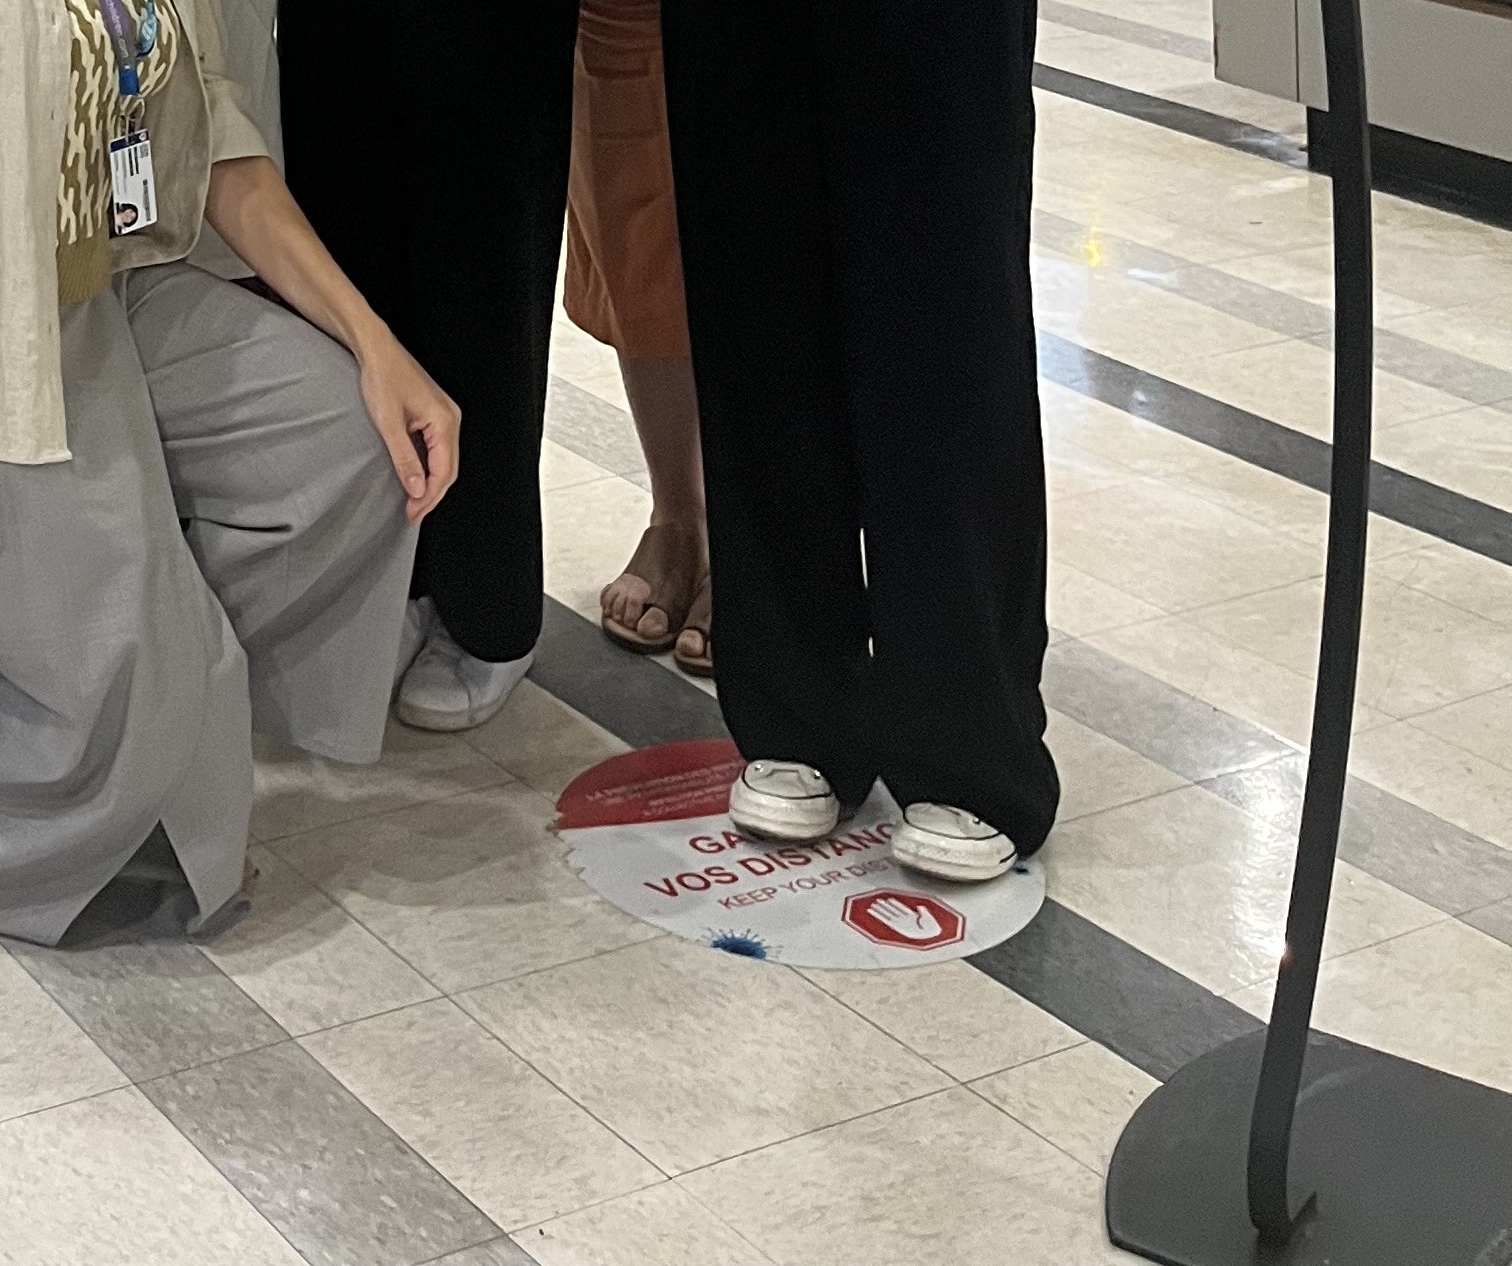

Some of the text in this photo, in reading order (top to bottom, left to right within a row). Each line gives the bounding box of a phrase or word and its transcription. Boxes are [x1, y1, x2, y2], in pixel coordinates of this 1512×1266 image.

[643, 823, 895, 898] VOS DISTANC
[718, 887, 778, 910] KEEP
[778, 869, 850, 894] YOUR
